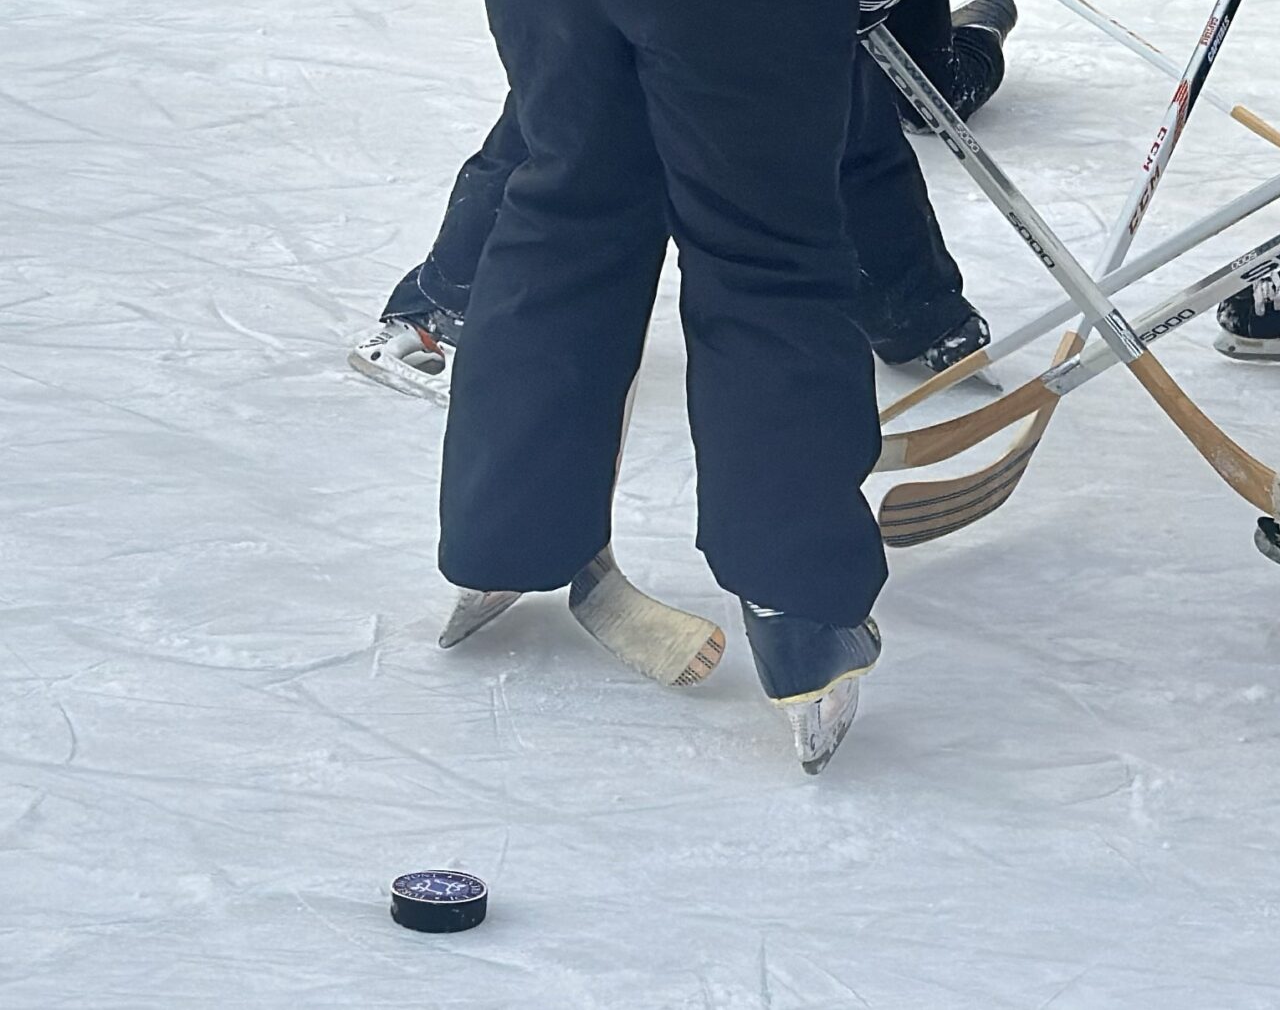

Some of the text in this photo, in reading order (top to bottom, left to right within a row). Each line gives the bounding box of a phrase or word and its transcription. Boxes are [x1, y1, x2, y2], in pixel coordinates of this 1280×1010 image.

[956, 123, 981, 154] 5000
[1143, 126, 1168, 172] CCM
[1129, 165, 1160, 235] CCM
[1007, 211, 1055, 269] 5000
[1139, 308, 1195, 343] 5000
